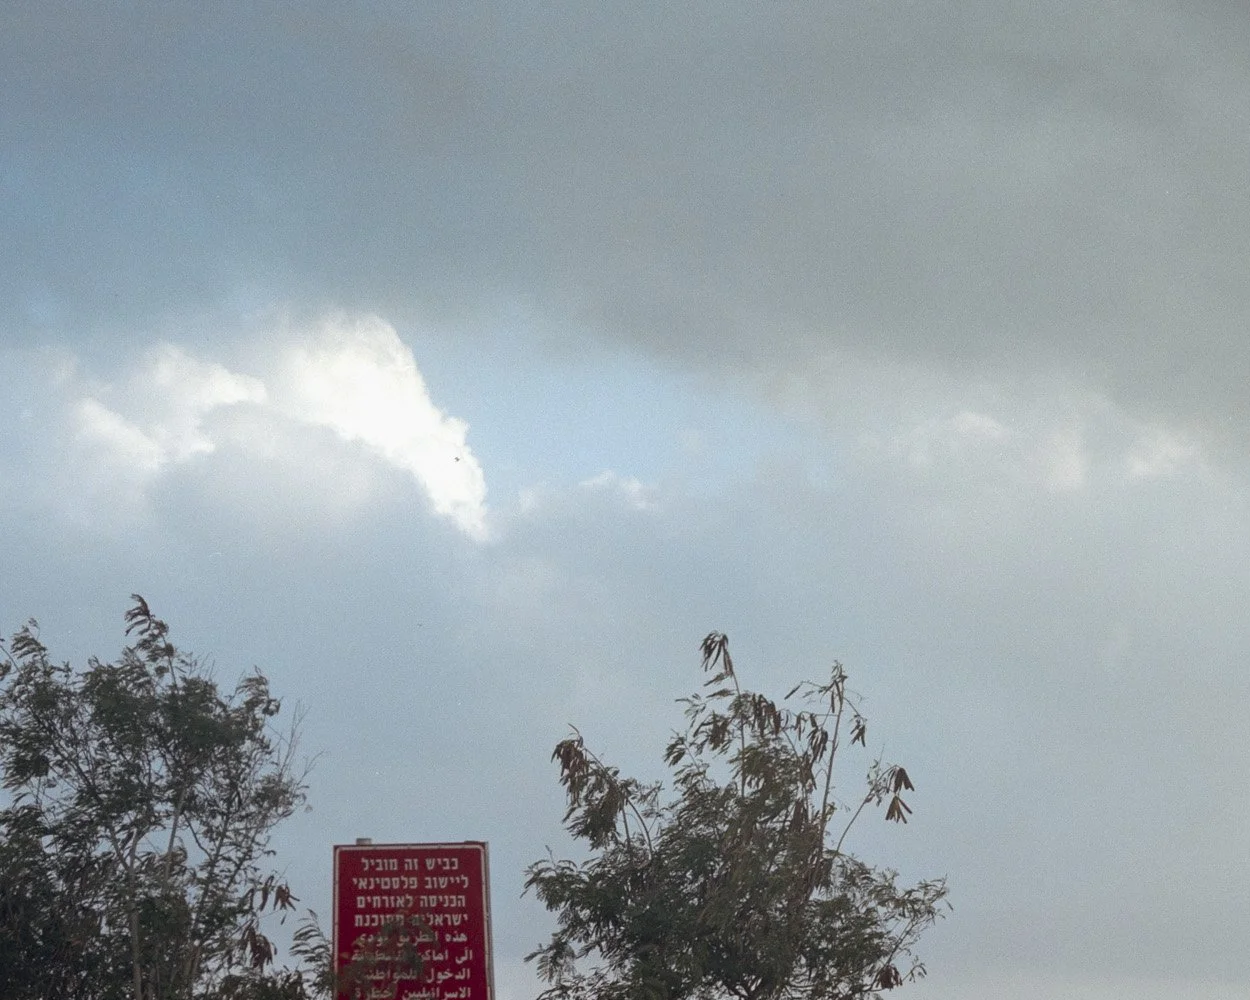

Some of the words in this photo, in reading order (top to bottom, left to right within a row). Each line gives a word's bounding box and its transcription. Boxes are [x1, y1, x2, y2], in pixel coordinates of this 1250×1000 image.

[361, 857, 399, 871] מוביל
[404, 858, 418, 871] זה
[425, 857, 459, 871] כביש
[352, 875, 418, 890] פלסטינאי
[424, 874, 469, 889] ליישוב
[356, 894, 414, 909] לאזרחים
[419, 895, 466, 908] הכניסה
[445, 931, 468, 942] هذه
